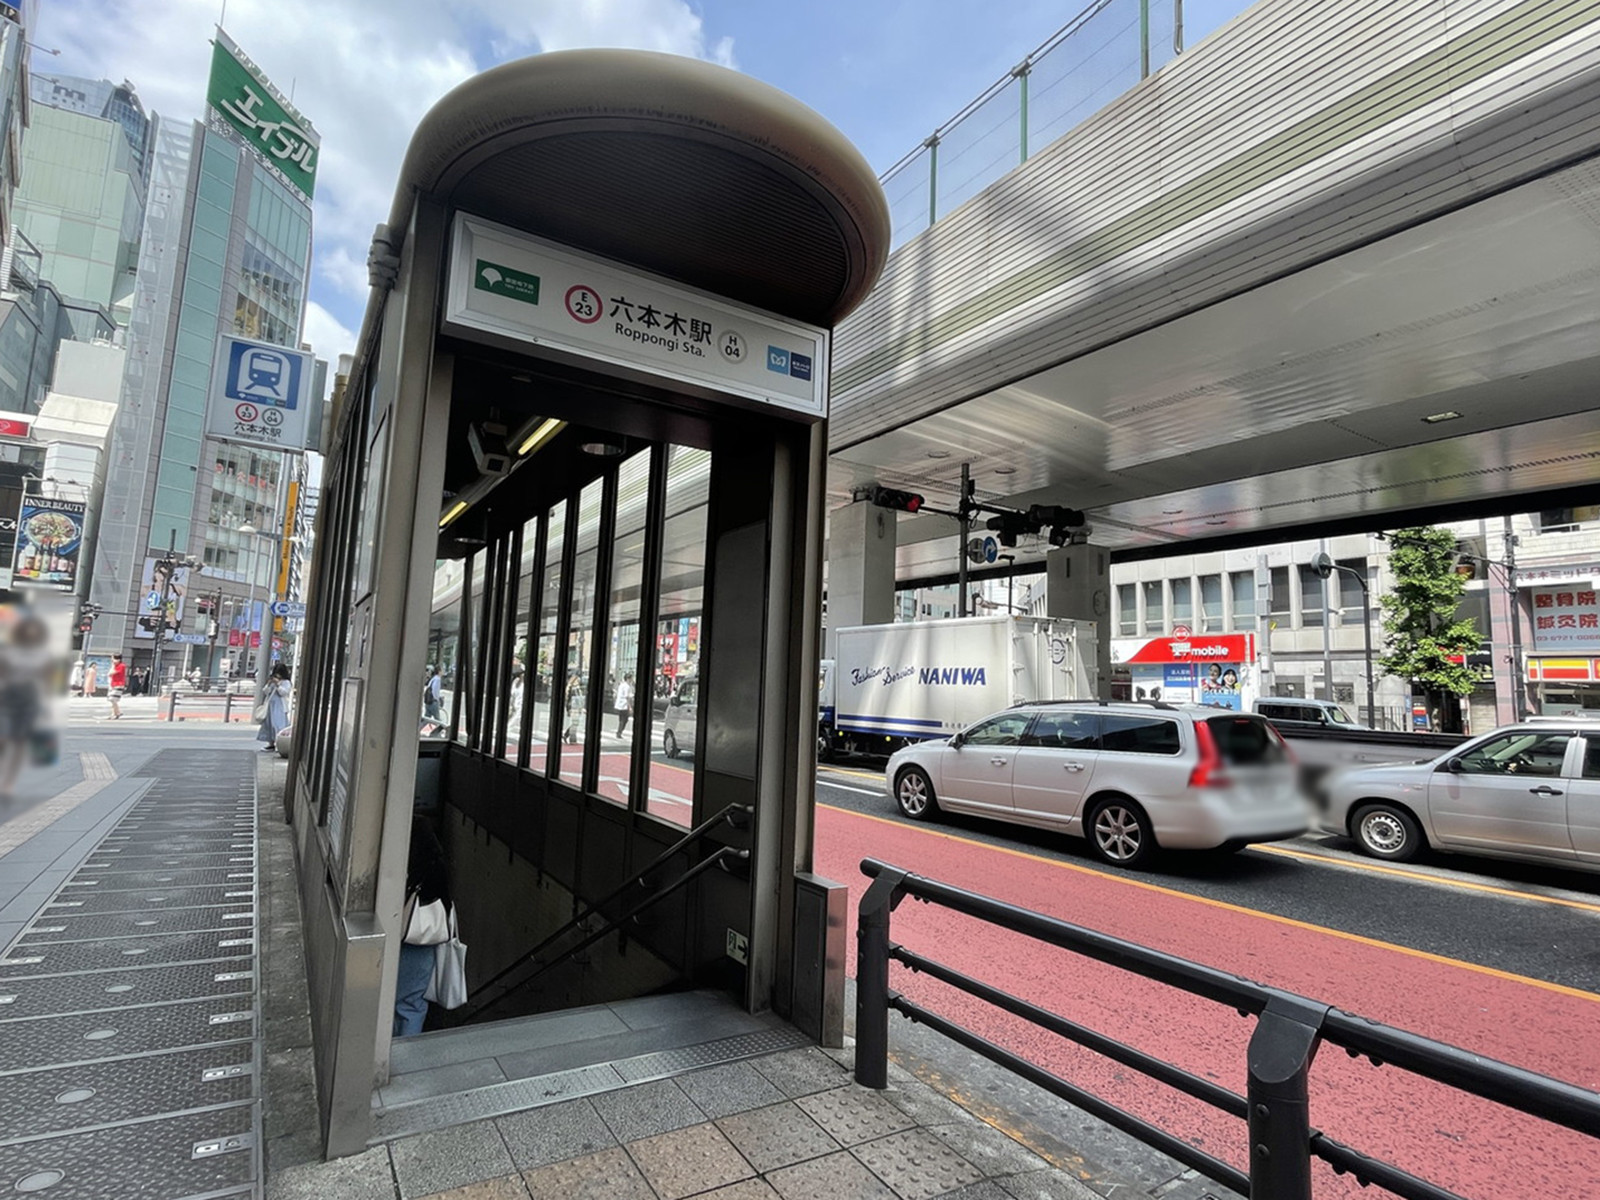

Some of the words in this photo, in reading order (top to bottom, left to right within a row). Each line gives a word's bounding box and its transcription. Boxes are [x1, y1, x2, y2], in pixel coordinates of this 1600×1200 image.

[228, 85, 315, 174] エイブル
[581, 291, 588, 302] E
[575, 302, 593, 316] 23
[609, 296, 712, 346] 六本木駅
[615, 323, 679, 351] Roppongi
[682, 341, 706, 358] Sta.
[729, 335, 737, 346] H
[725, 346, 741, 358] 04
[234, 422, 281, 438] 六本木駅
[25, 498, 52, 508] INNER
[52, 501, 85, 512] BEAUTY
[1535, 590, 1597, 608] 整骨院
[1536, 613, 1599, 630] 鍼灸院
[918, 667, 986, 685] NANIWA
